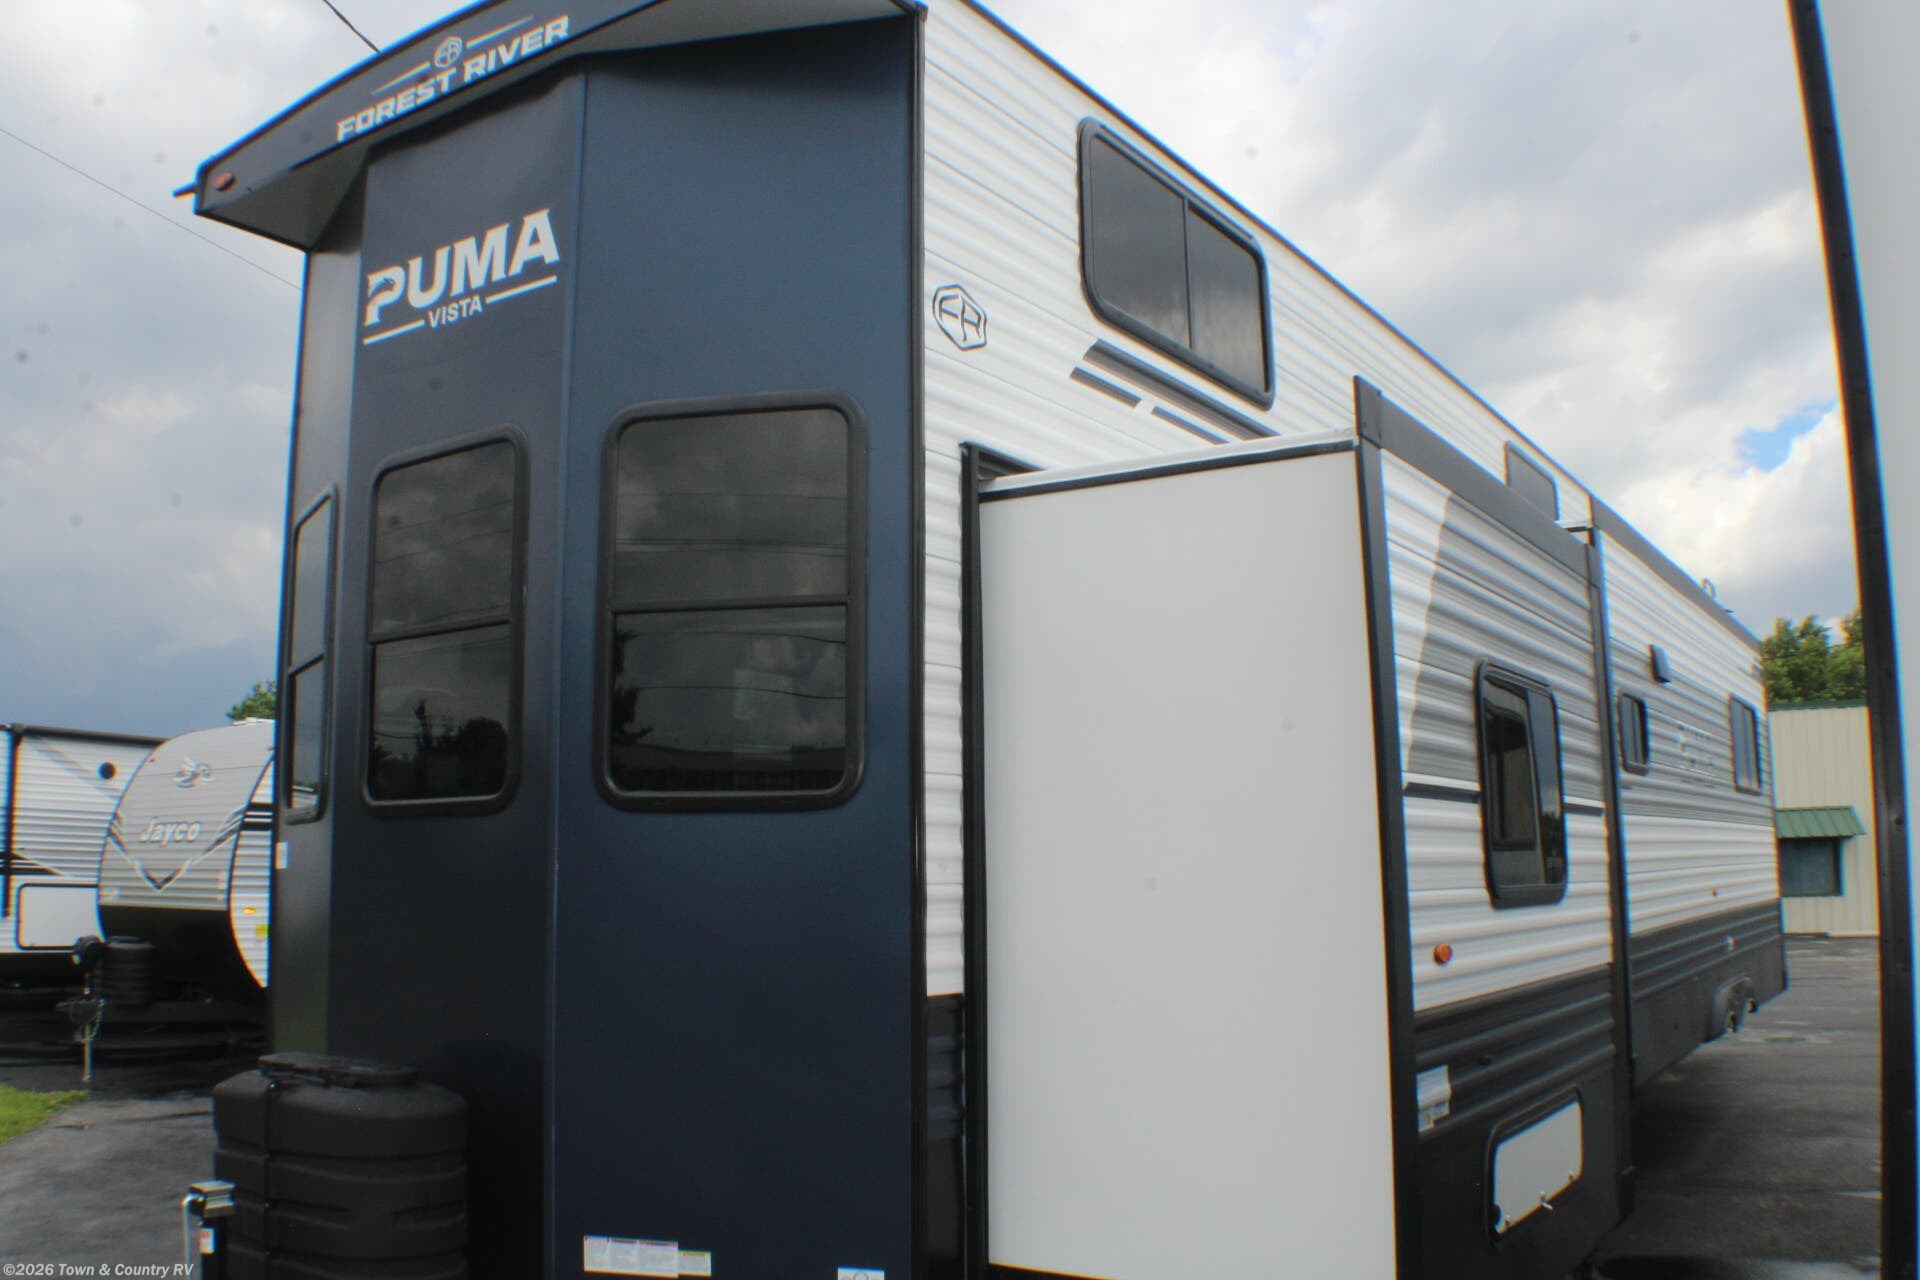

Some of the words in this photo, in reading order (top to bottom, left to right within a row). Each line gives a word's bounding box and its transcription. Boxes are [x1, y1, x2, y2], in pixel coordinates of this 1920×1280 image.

[337, 67, 457, 142] FOREST
[463, 15, 570, 83] RIVER
[363, 209, 559, 327] PUMA
[427, 298, 483, 328] VISTA
[139, 818, 202, 847] Jayco
